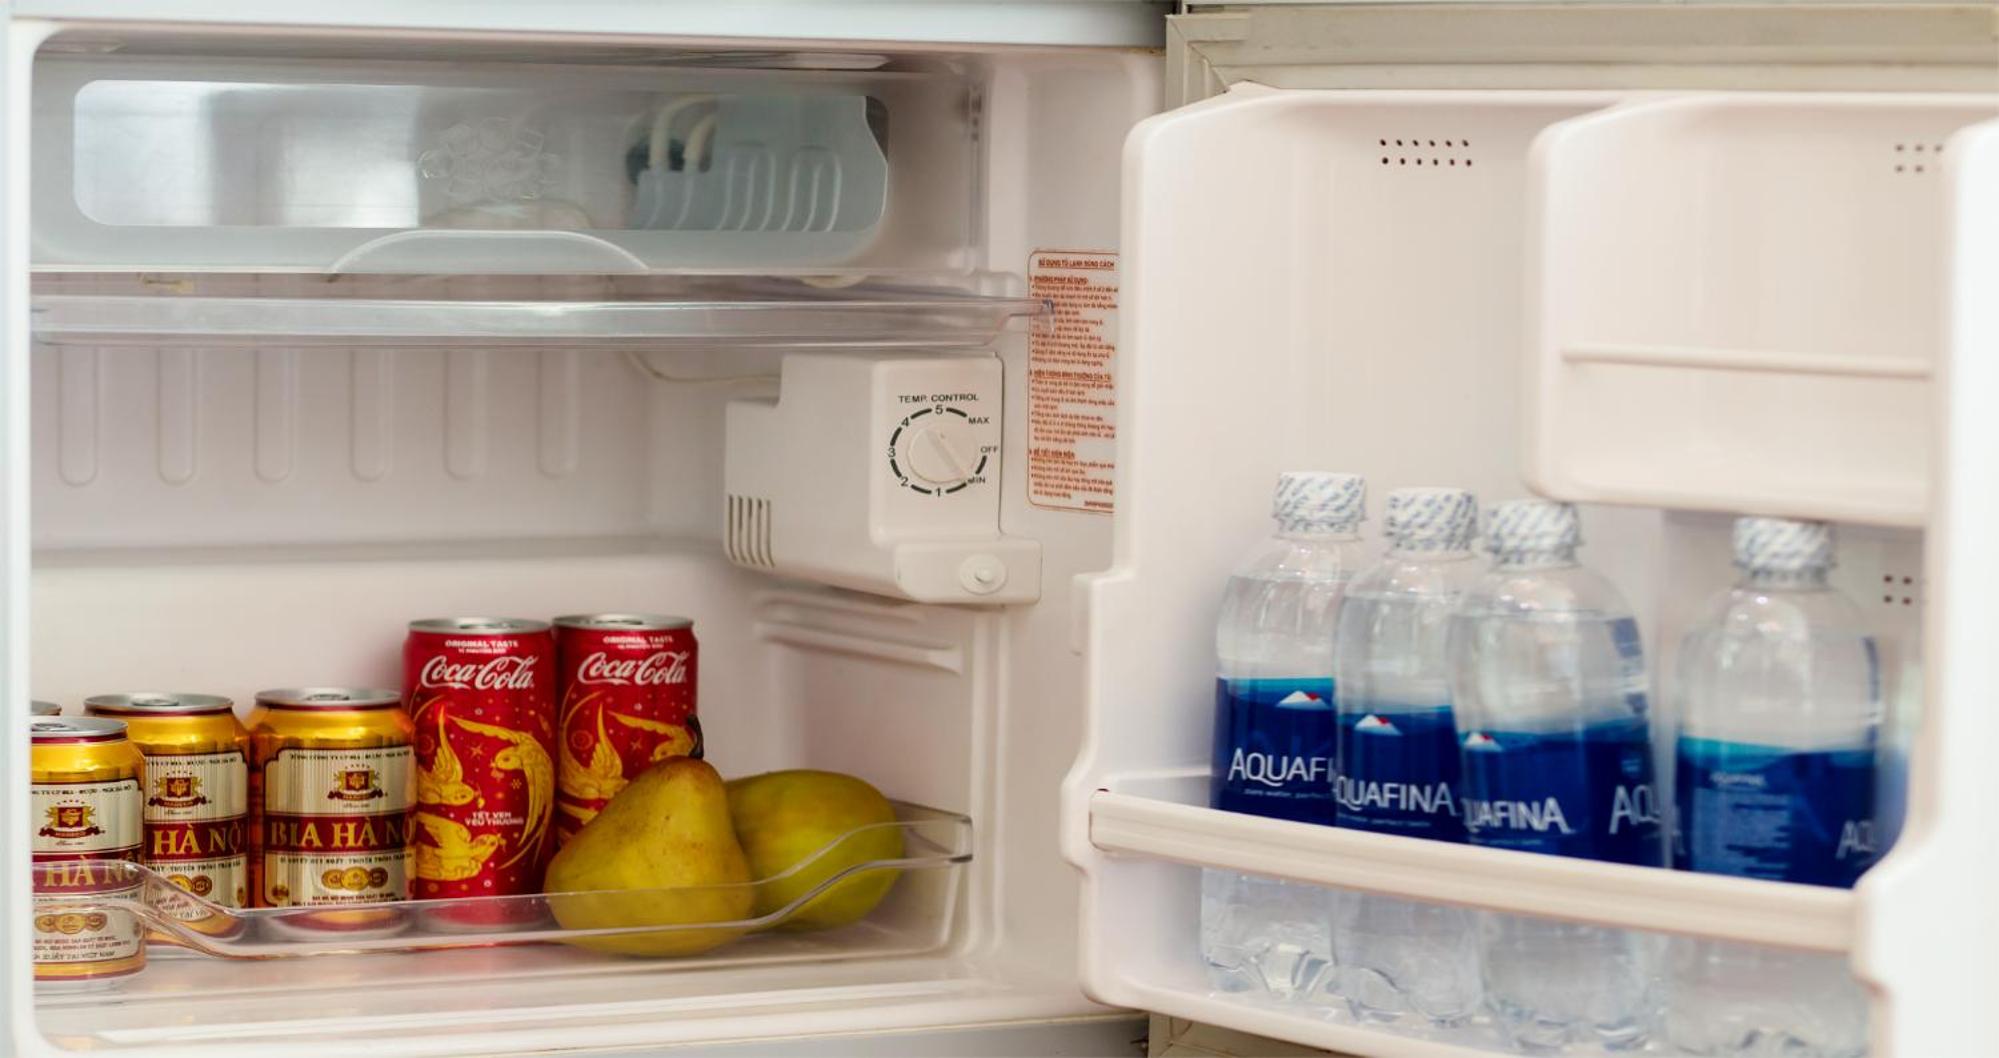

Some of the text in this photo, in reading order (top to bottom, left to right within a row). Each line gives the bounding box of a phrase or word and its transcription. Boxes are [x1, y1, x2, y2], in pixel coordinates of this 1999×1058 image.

[931, 393, 979, 402] CONTROL
[935, 404, 943, 415] 5
[901, 416, 909, 427] 4
[968, 417, 990, 425] MAX
[887, 447, 896, 458] 3
[901, 476, 909, 487] 2
[967, 476, 986, 484] MIN
[936, 487, 941, 497] 1
[270, 821, 323, 848] BIA
[330, 816, 379, 848] HÀ
[152, 822, 202, 856] HÀ
[43, 854, 96, 887] HÀ
